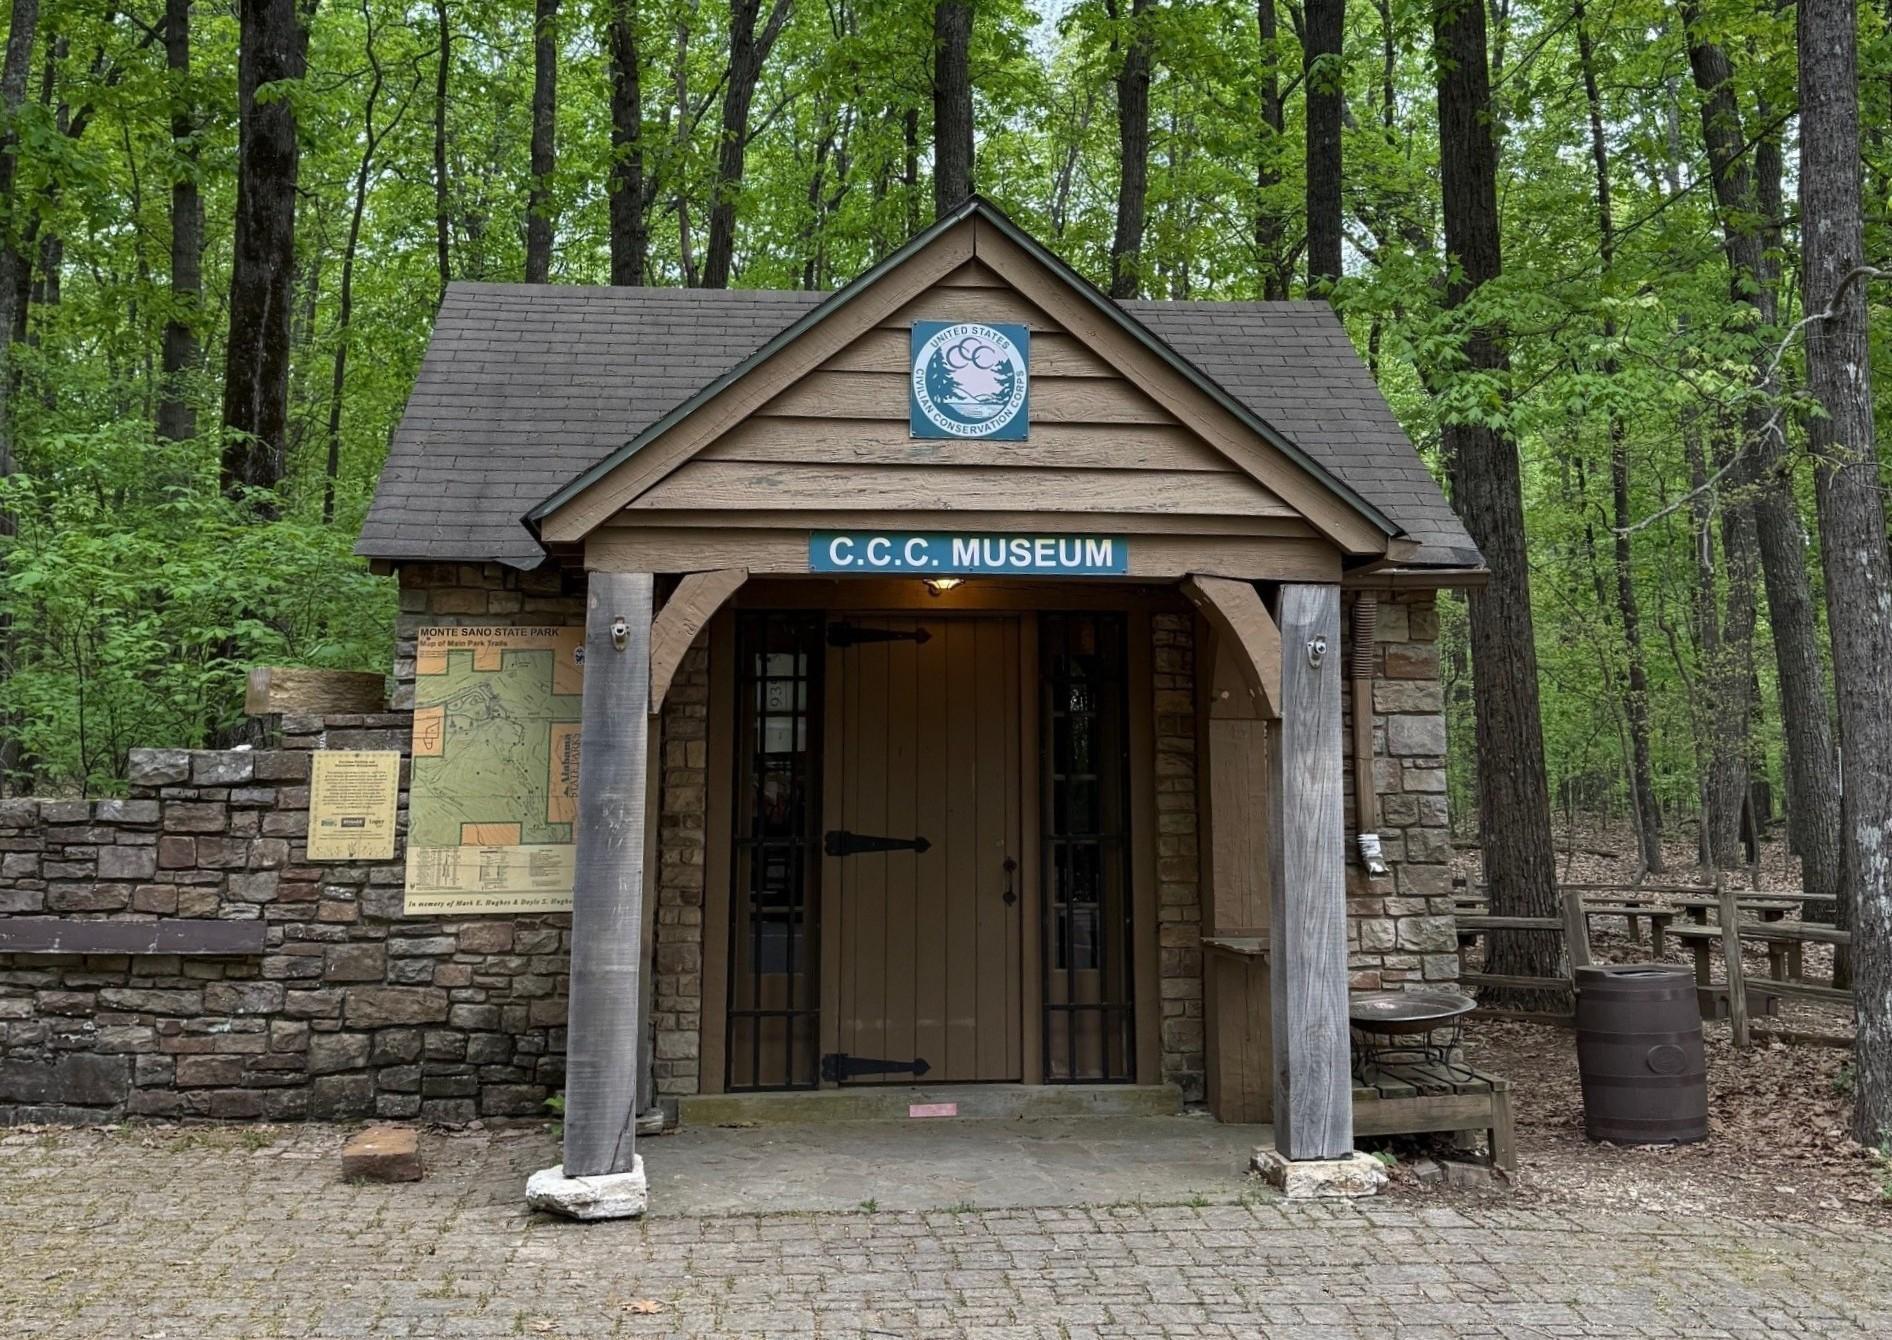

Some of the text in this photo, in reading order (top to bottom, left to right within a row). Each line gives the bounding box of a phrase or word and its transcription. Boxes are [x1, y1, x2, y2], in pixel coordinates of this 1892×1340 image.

[930, 326, 1010, 350] UNITED STATES
[915, 368, 1025, 435] CIVILIAN CONSERVATION CORPS
[829, 536, 1113, 568] C.C.C. MUSEUM
[420, 627, 560, 637] MONTE SANO STATE PARK
[420, 638, 508, 648] Map of Main Park Trails
[446, 900, 455, 908] of
